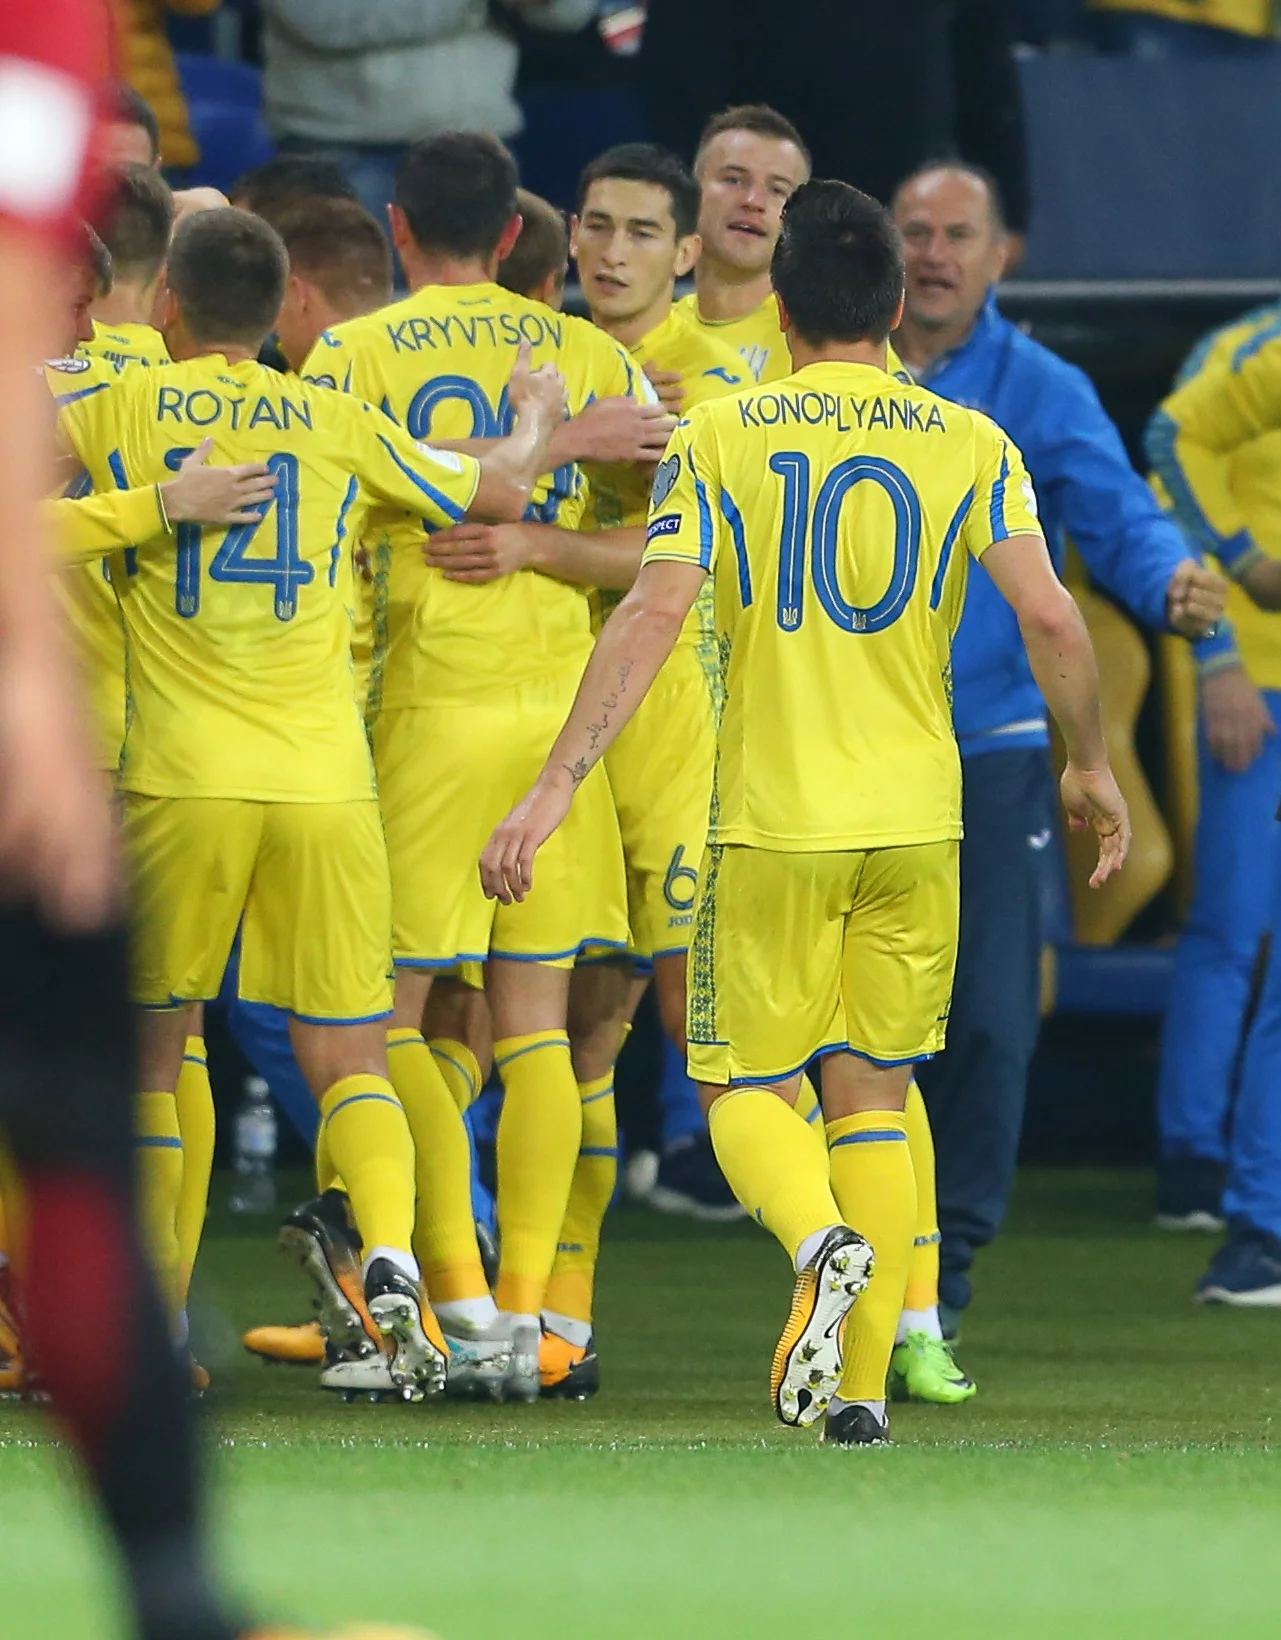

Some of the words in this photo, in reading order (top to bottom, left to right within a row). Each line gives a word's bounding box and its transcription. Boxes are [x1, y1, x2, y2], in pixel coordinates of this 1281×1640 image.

[386, 314, 562, 353] KRYVTSOV
[738, 392, 946, 434] KONOPLYANKA
[164, 447, 315, 622] 14
[769, 451, 922, 635] 10
[663, 844, 698, 911] 6
